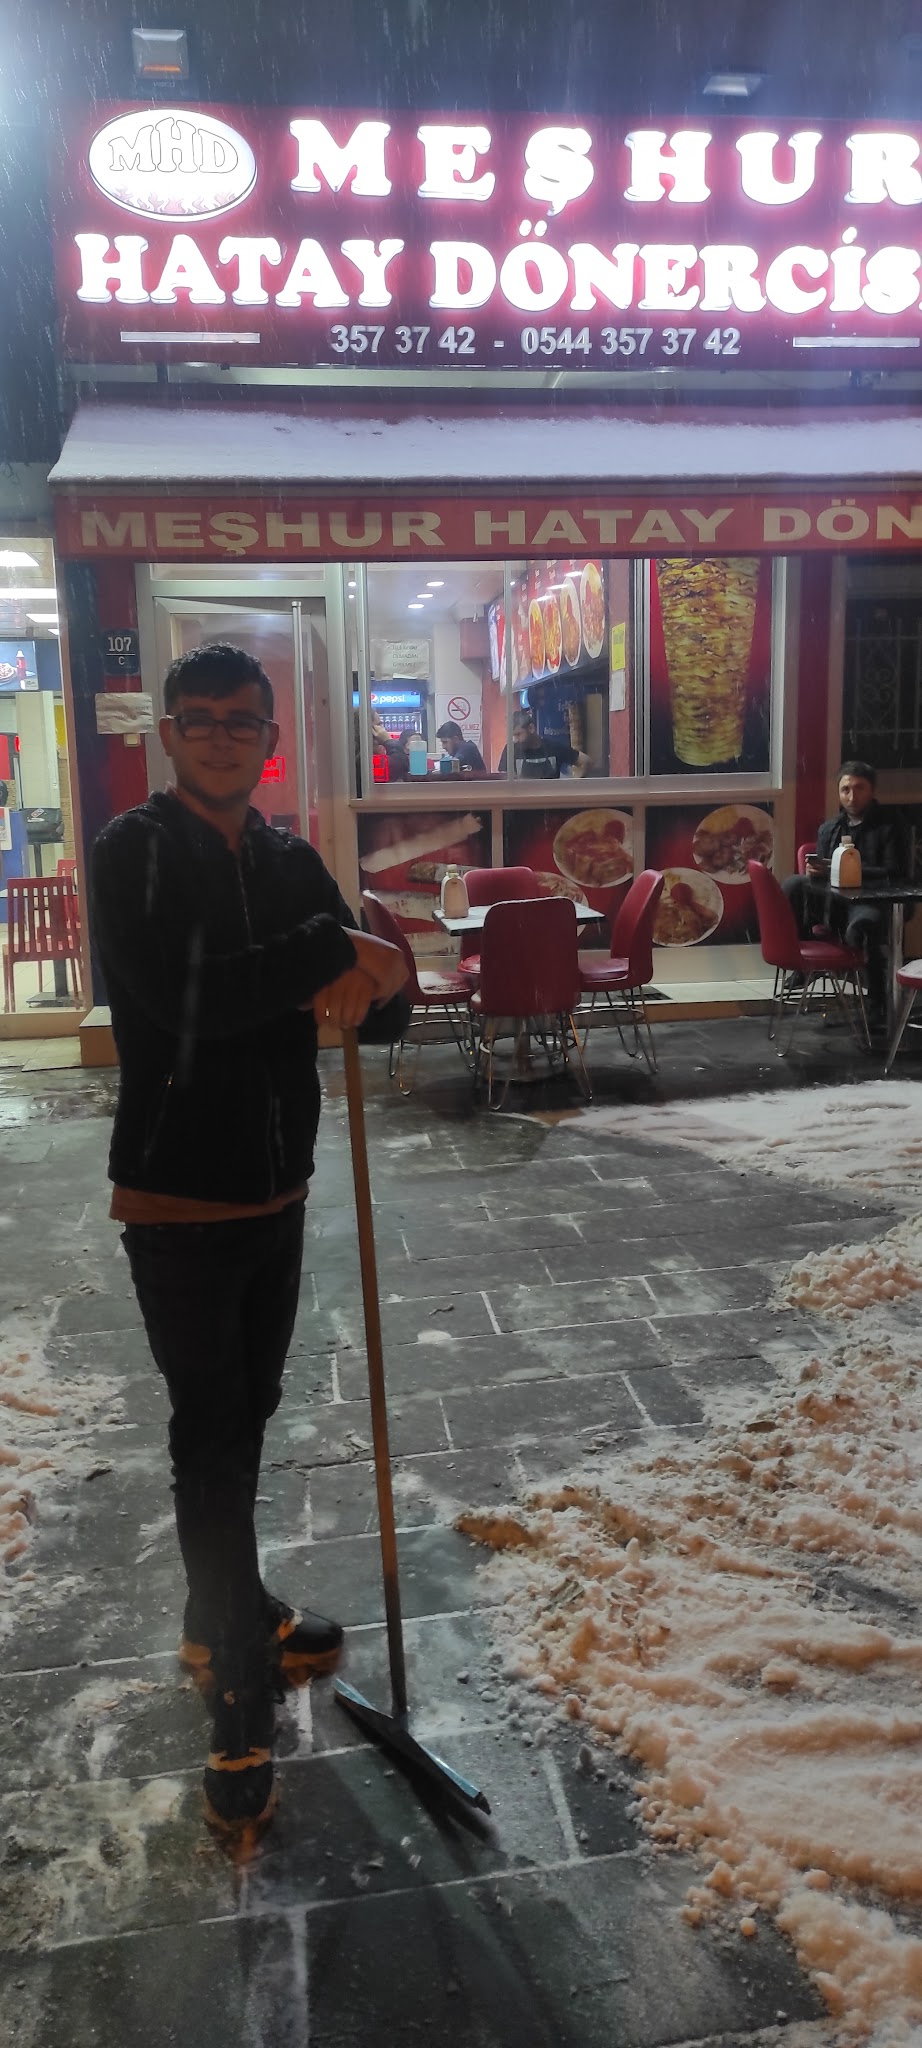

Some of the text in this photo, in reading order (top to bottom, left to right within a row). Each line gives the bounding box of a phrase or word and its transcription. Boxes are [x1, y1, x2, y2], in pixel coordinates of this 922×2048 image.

[108, 117, 239, 173] MHD
[289, 119, 922, 216] MEŞHUR
[75, 219, 922, 314] HATAY DÖNERCİS
[331, 326, 385, 354] 357
[395, 326, 430, 354] 37
[438, 326, 476, 354] 42
[521, 327, 592, 355] 0544
[601, 328, 653, 355] 357
[662, 328, 697, 355] 37
[703, 328, 741, 355] 42
[81, 511, 443, 556] MEŞHUR
[475, 508, 734, 545] HATAY
[108, 636, 132, 652] 107
[118, 656, 125, 665] C
[380, 694, 405, 704] pepsi
